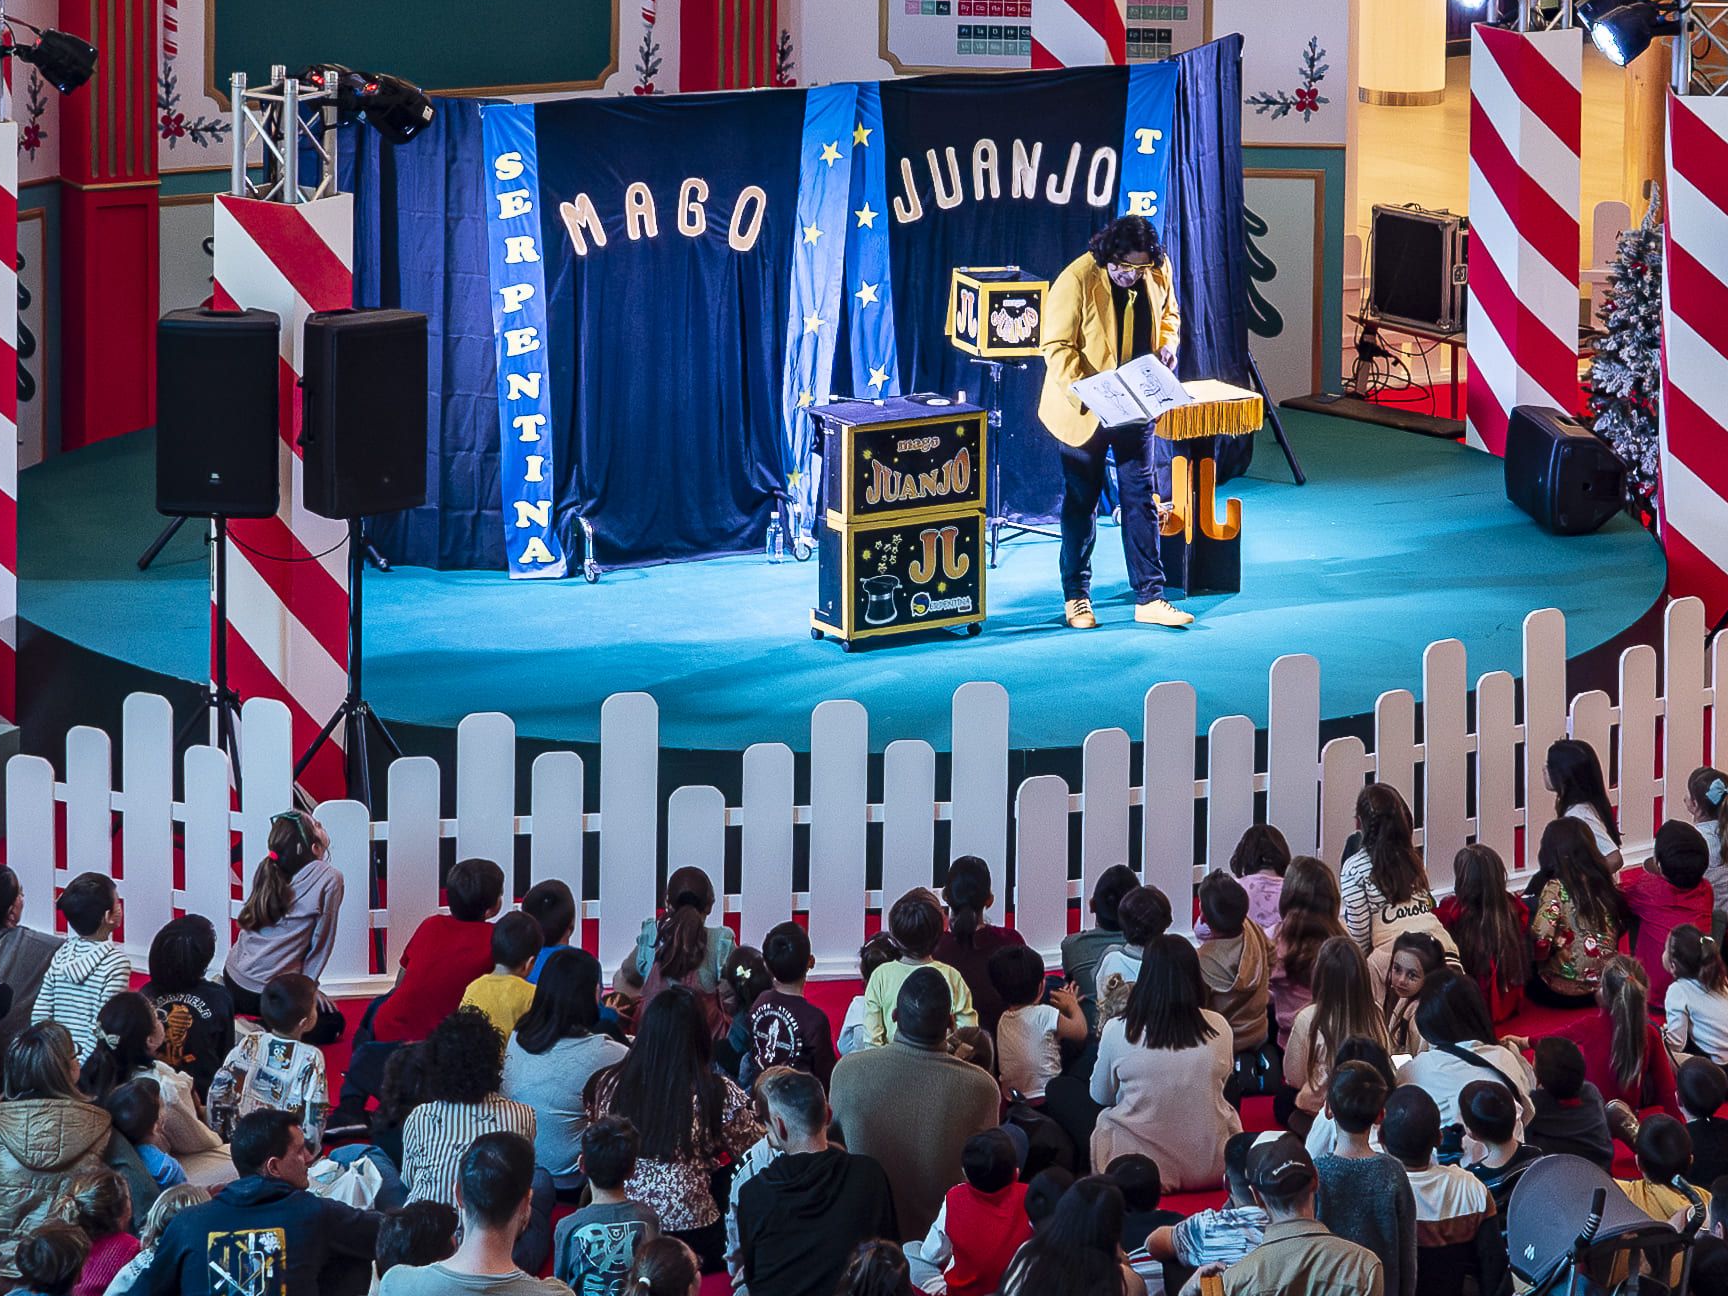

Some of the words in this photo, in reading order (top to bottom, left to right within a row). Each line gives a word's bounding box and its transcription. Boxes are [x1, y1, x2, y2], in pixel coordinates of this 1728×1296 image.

[893, 137, 1118, 224] JUANJO
[560, 177, 766, 256] MAGO
[495, 151, 557, 565] SERPENTINA
[866, 447, 971, 505] JUANJO
[897, 436, 941, 453] mago
[909, 526, 970, 584] JJ
